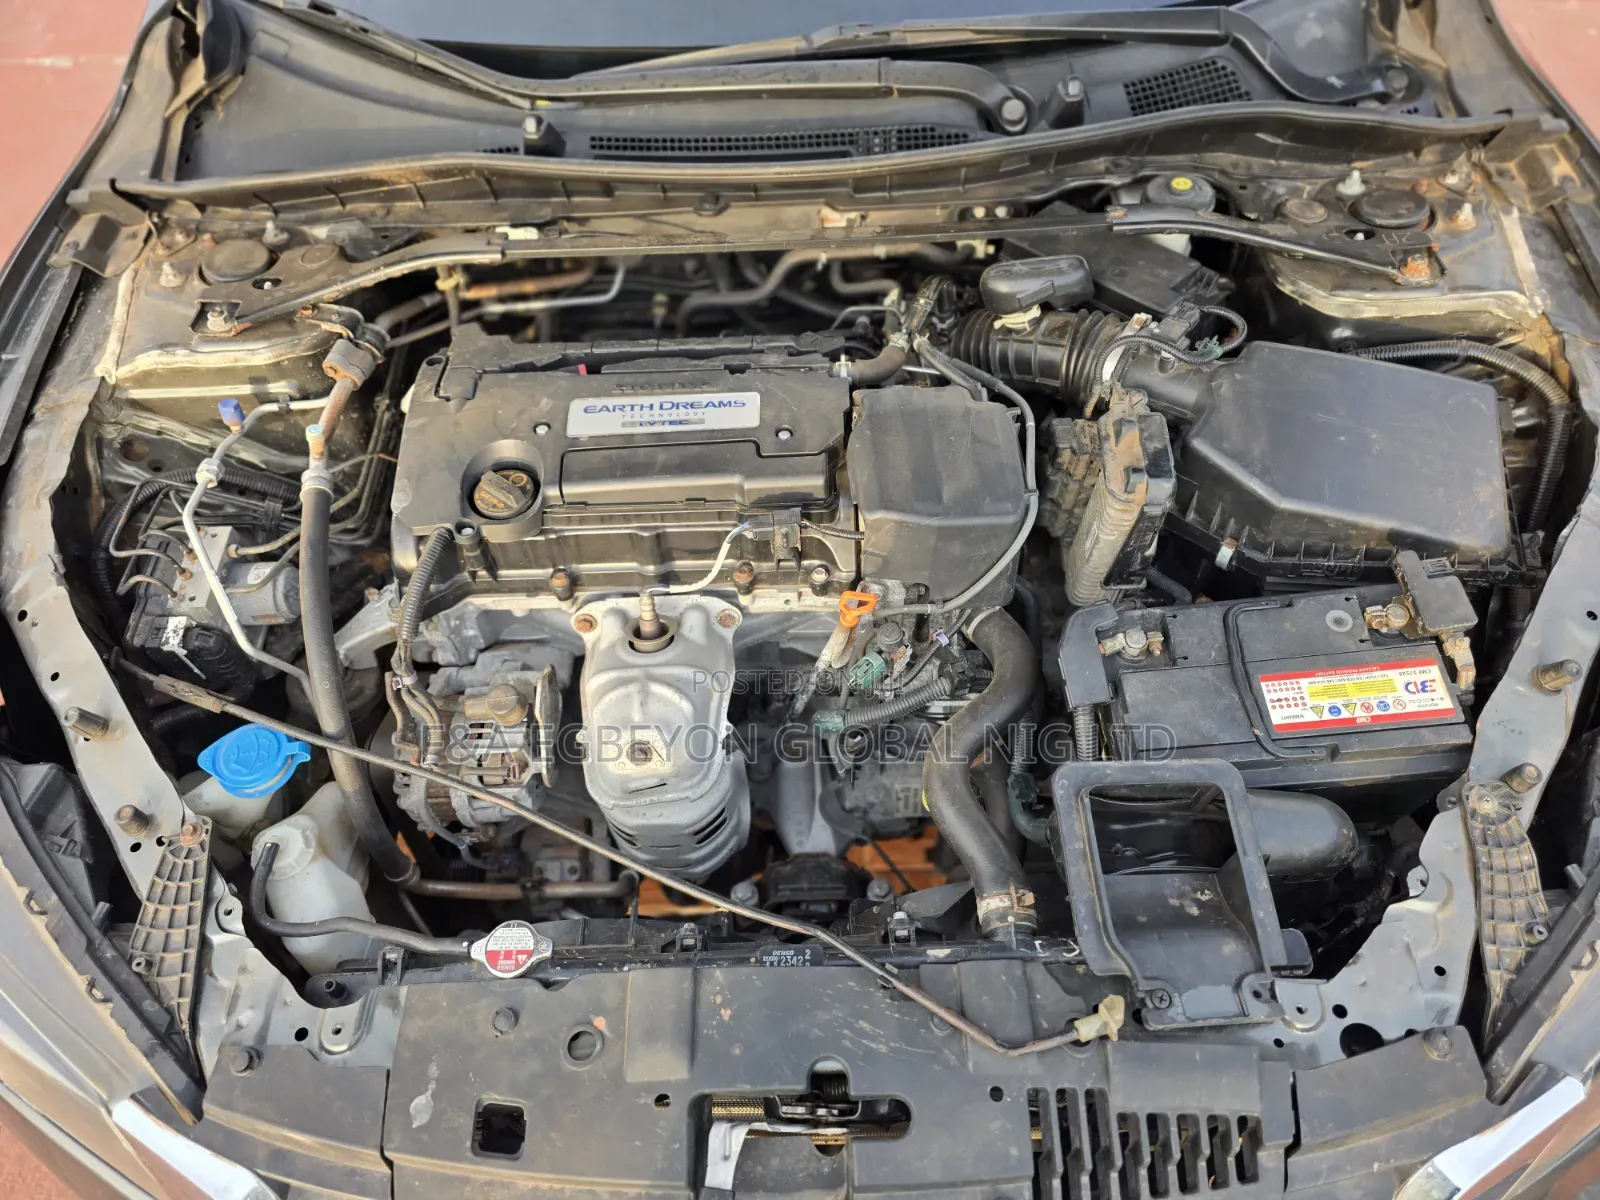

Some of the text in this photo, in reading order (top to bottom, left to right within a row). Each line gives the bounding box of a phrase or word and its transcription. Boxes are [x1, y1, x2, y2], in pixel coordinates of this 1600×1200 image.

[583, 400, 747, 414] EARTH DREAMS
[622, 411, 706, 419] TECHNOLOGY
